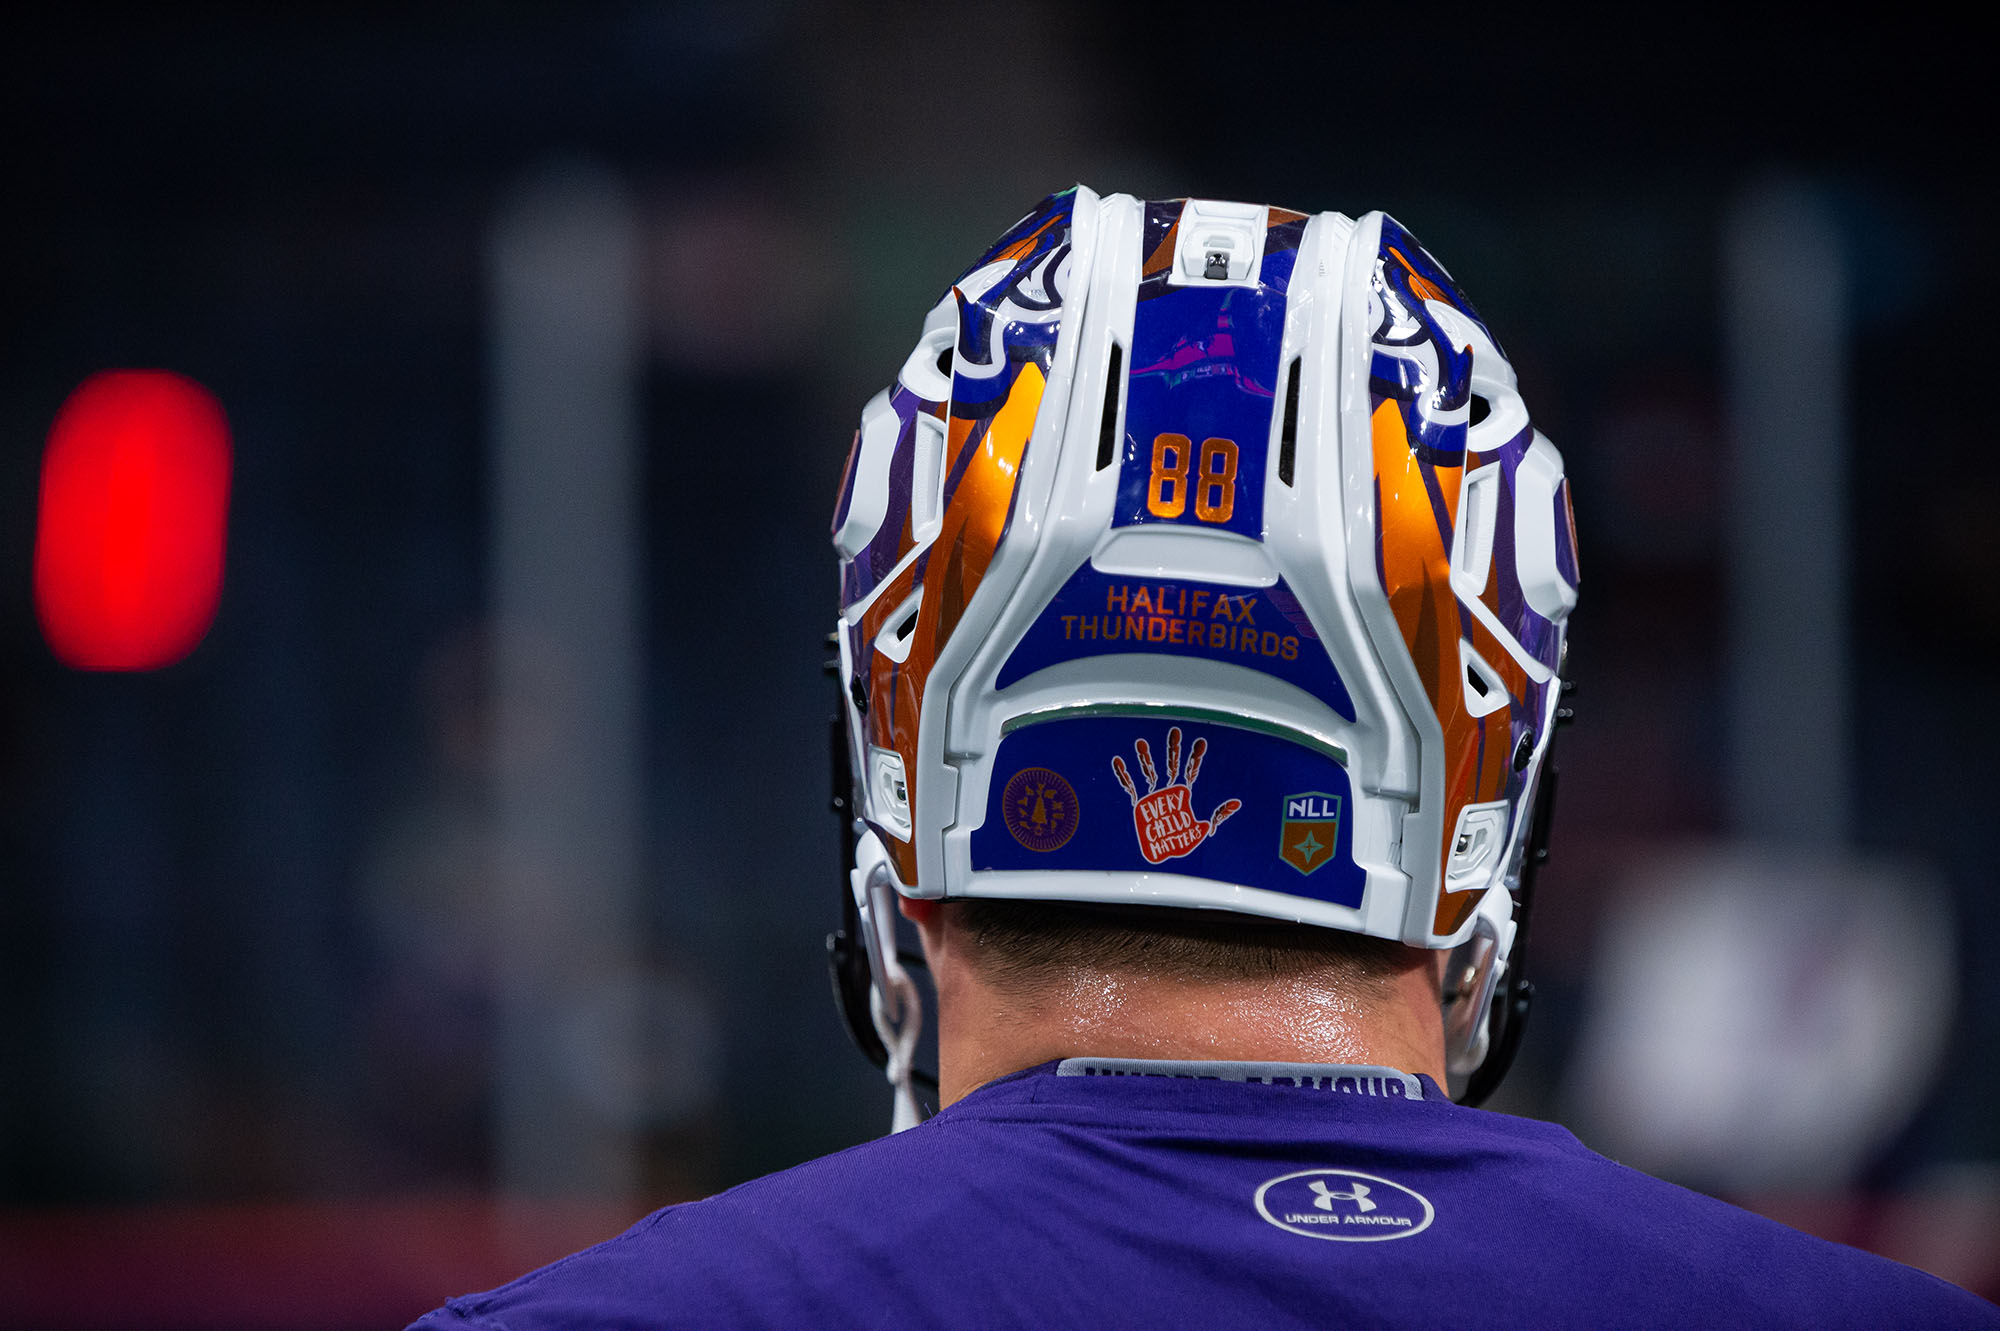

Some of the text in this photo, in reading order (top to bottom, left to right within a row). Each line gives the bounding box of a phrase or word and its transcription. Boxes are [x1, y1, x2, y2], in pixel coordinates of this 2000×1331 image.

[1147, 432, 1239, 523] 88
[1106, 585, 1257, 625] HALIFAX
[1060, 615, 1300, 660] THUNDERBIRDS
[1140, 789, 1185, 823] EVERY
[1288, 798, 1335, 817] NLL
[1145, 810, 1192, 843] CHILD
[1149, 824, 1202, 860] MATTERS
[1285, 1214, 1412, 1227] UNDER ARMOUR
